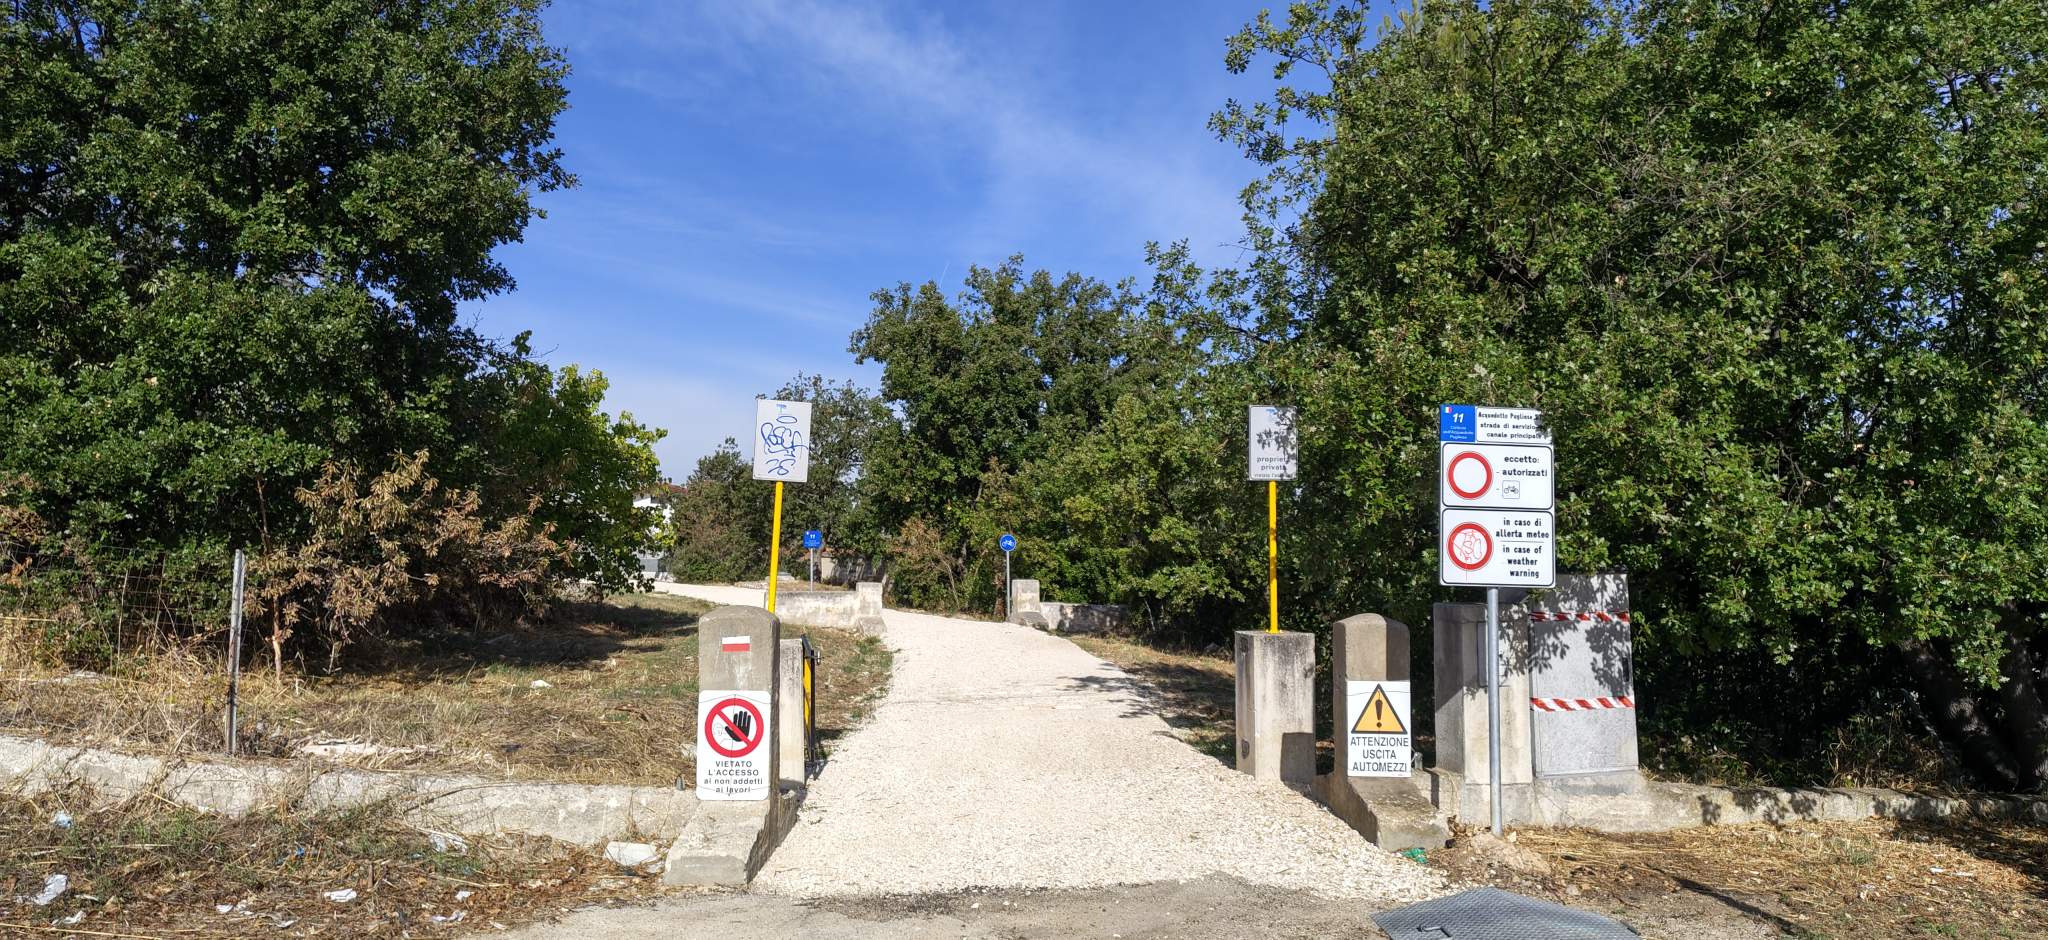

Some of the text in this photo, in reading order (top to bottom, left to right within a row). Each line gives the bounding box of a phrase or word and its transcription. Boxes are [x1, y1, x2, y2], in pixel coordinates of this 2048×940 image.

[1453, 413, 1464, 423] 11
[1504, 455, 1540, 463] eccetto:
[1502, 469, 1548, 477] autorizzati
[1503, 517, 1511, 526] in
[1534, 518, 1542, 527] di
[1496, 529, 1550, 539] allerta meteo
[1502, 545, 1510, 553] in
[1534, 545, 1543, 554] of
[1507, 557, 1538, 566] weather
[1510, 569, 1540, 579] warning
[1350, 736, 1409, 747] ATTENZIONE
[1362, 749, 1397, 760] USCITA
[715, 760, 753, 768] VIETATO
[1352, 761, 1407, 772] AUTOMEZZI
